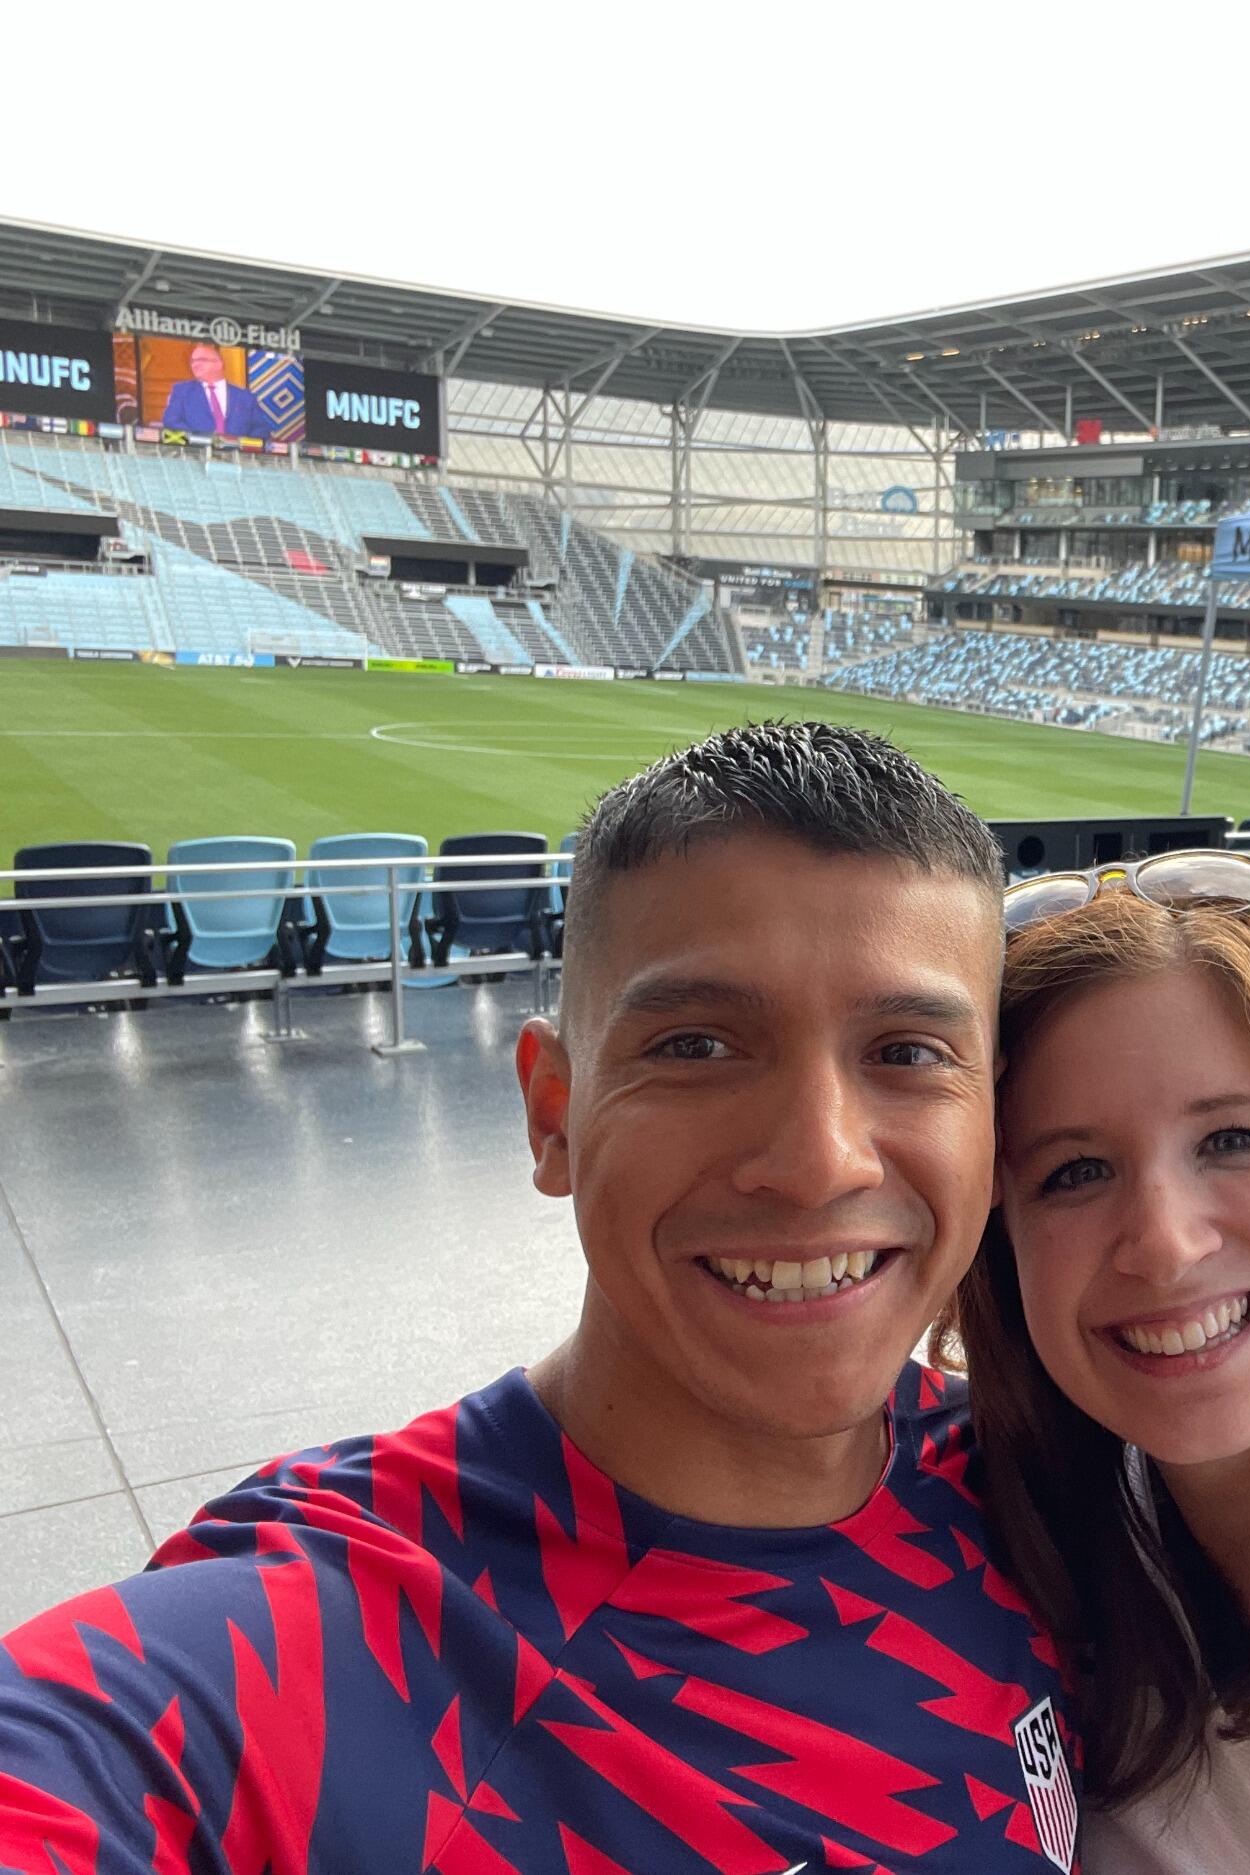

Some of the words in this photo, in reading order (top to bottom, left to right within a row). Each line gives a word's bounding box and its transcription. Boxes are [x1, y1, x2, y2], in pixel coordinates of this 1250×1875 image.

[115, 306, 205, 338] Allianz
[247, 324, 301, 350] Field
[326, 389, 421, 429] MNUFC
[1017, 1706, 1058, 1781] USA
